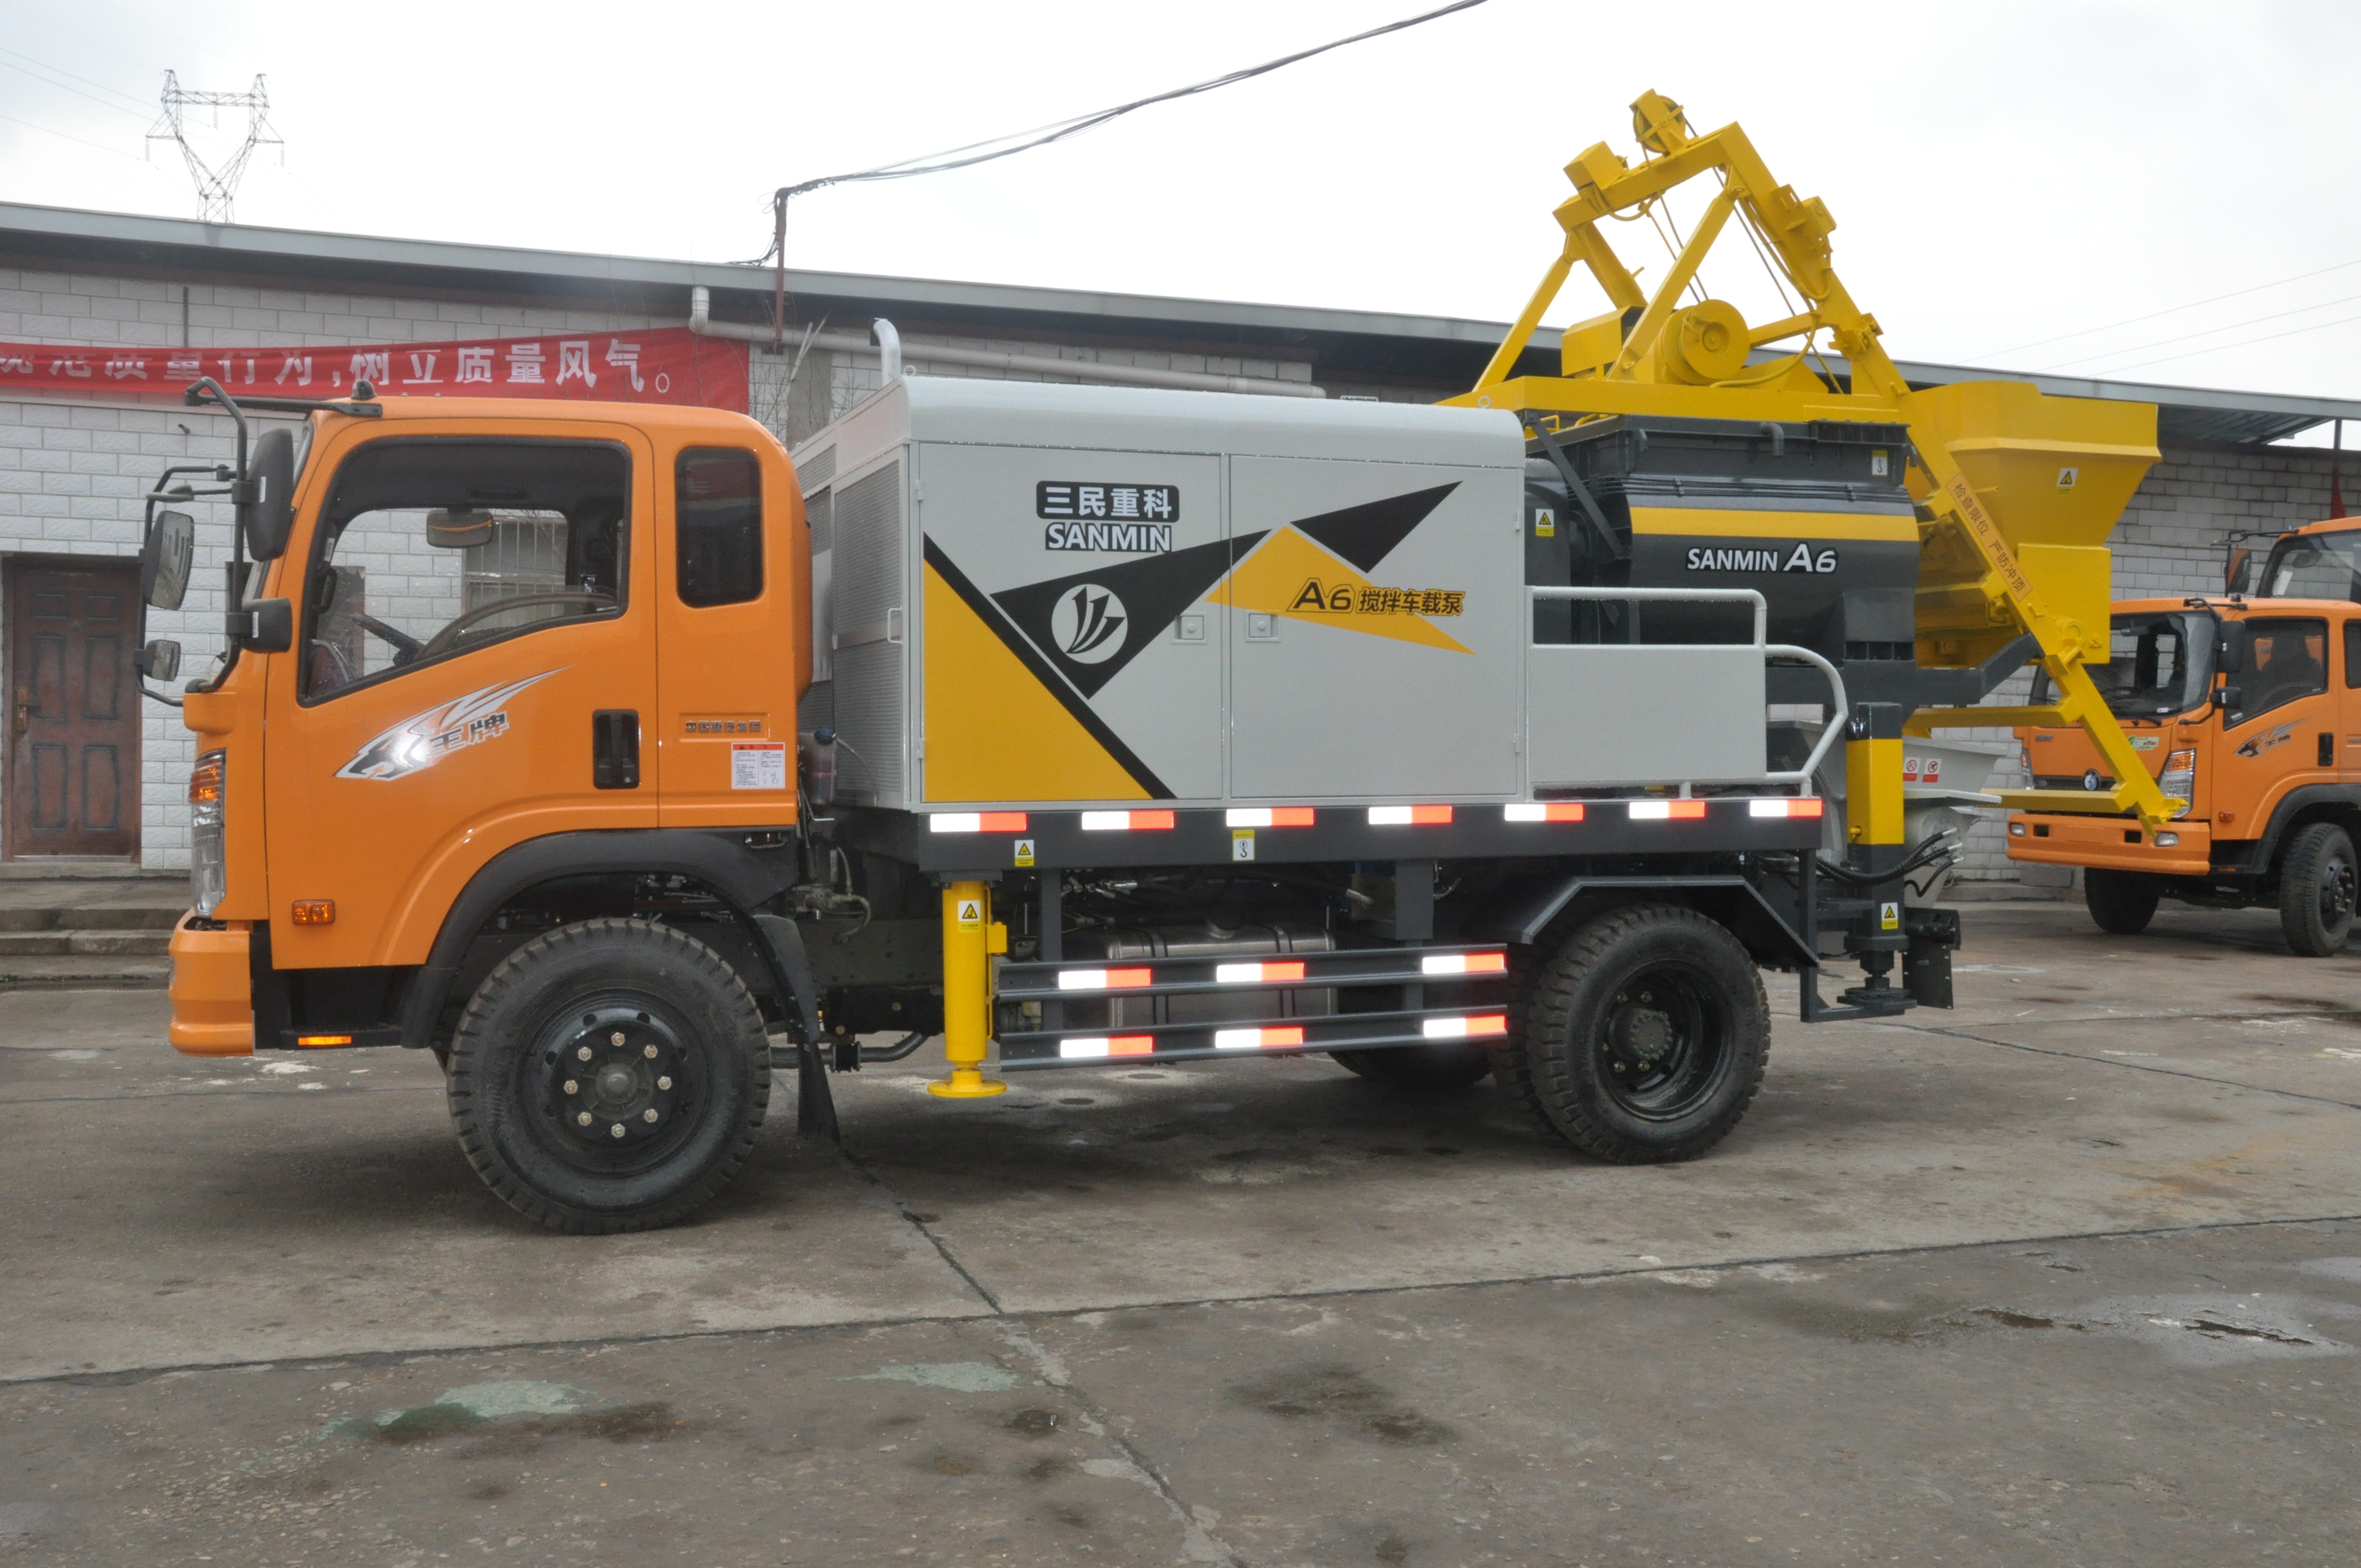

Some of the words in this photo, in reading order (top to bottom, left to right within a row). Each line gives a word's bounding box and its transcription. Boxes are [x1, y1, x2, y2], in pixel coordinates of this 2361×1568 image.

[1044, 486, 1172, 519] 三民重科
[1048, 523, 1170, 551] SANMIN
[1954, 483, 1990, 536] 检查限位
[1988, 539, 2026, 594] 严防冲顶
[1687, 548, 1778, 571] SANMIN
[1783, 543, 1837, 573] A6
[1293, 581, 1352, 611] A6
[1358, 590, 1464, 614] 搅拌车载泵
